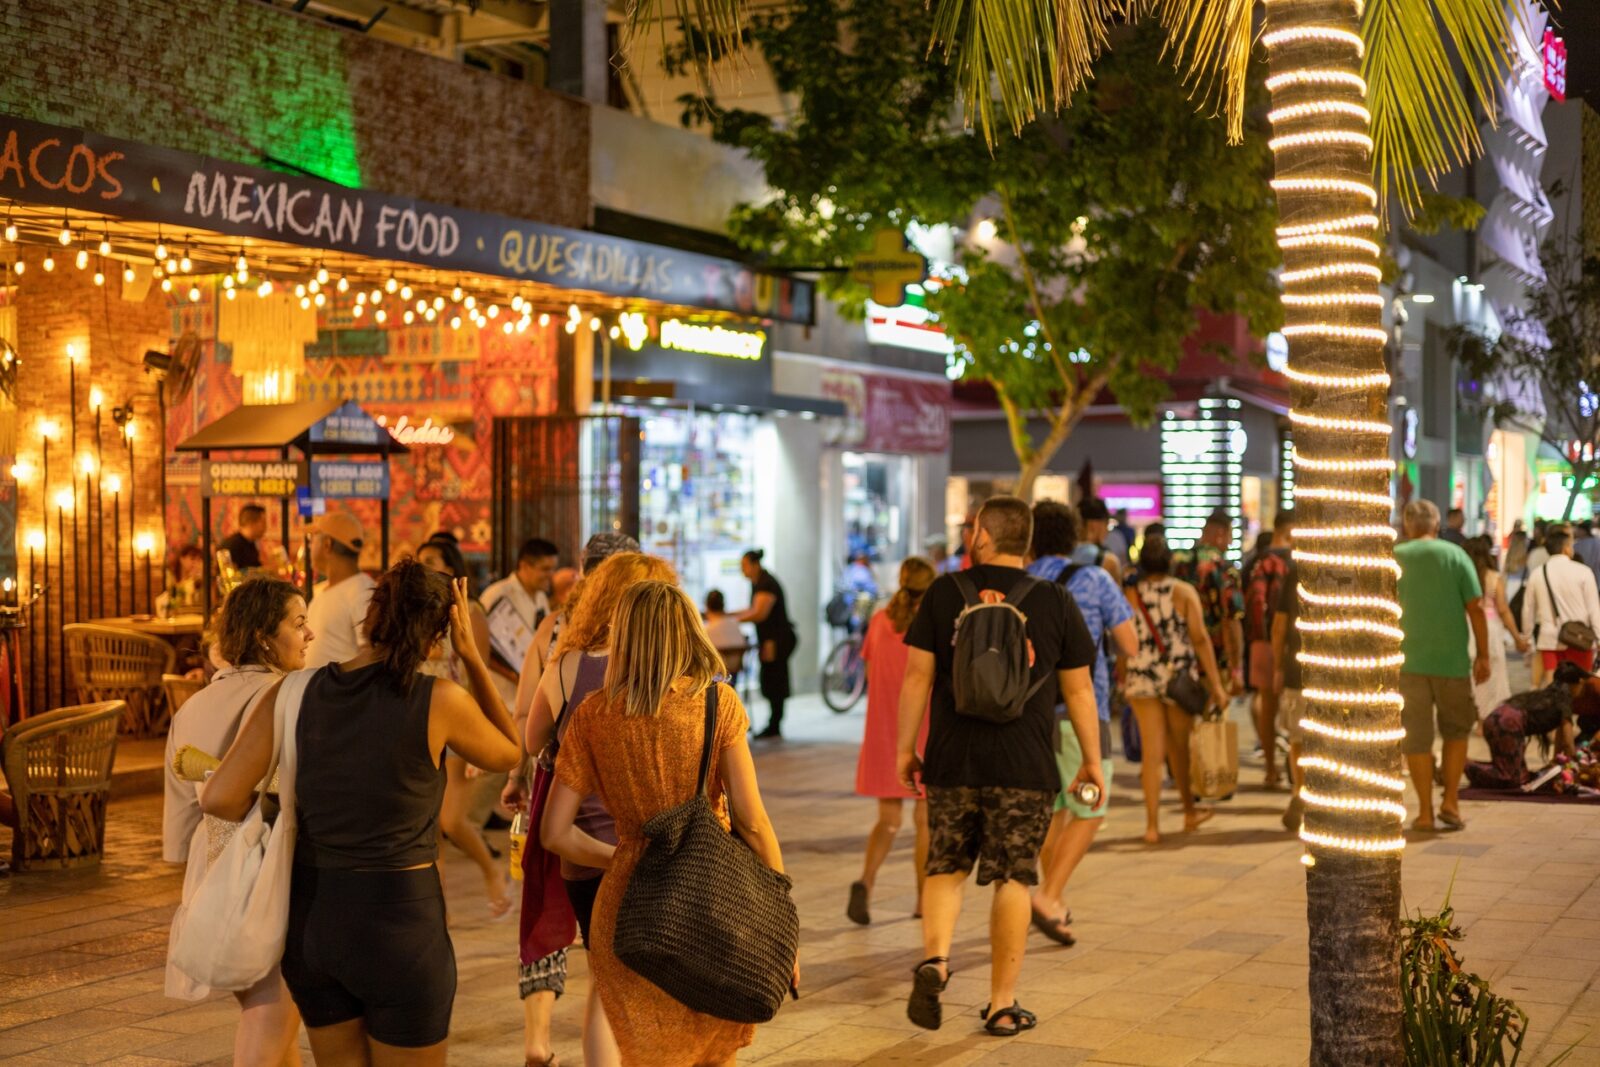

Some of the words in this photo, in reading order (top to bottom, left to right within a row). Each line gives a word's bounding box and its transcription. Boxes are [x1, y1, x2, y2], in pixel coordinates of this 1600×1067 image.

[0, 130, 125, 199] ACOS
[184, 171, 364, 244] MEXICAN
[376, 205, 460, 257] FOOD
[500, 229, 673, 293] QUESADILLAS
[210, 463, 263, 479] ORDENA
[318, 464, 357, 479] ORDENA
